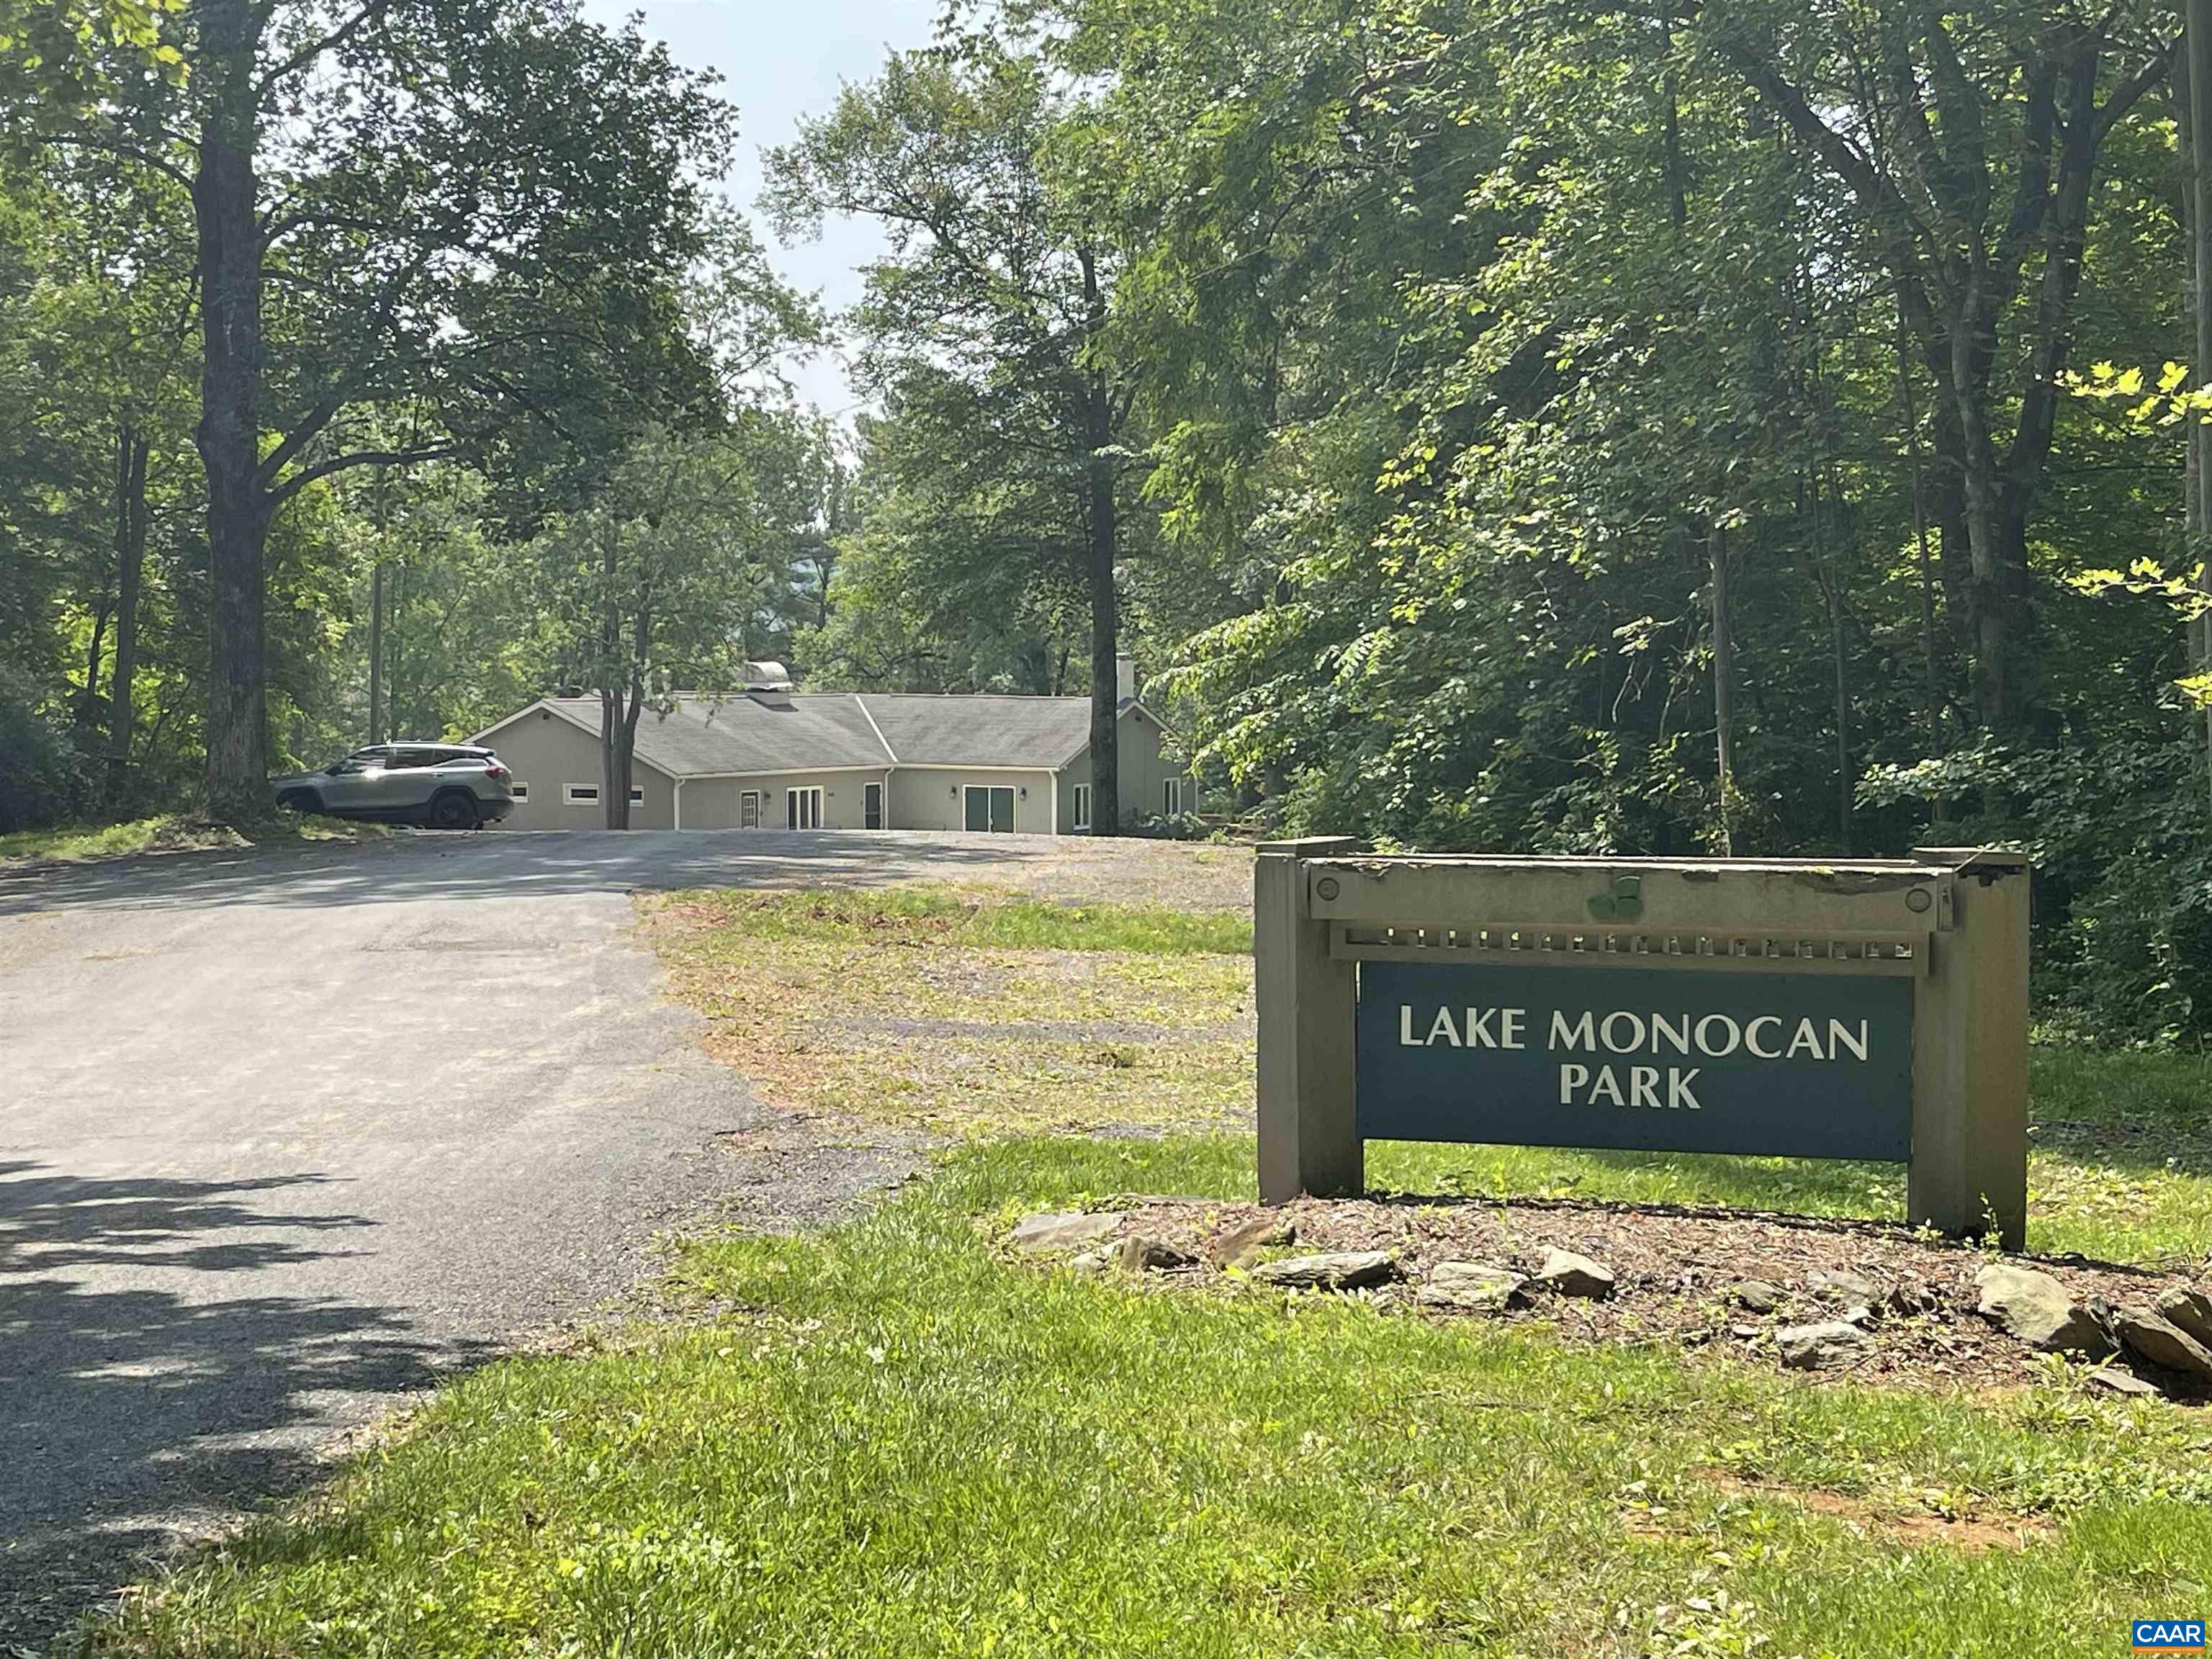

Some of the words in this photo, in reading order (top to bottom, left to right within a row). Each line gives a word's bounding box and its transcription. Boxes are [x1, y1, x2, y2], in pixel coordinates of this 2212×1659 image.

[1401, 1005, 1525, 1049] LAKE
[1547, 1010, 1868, 1061] MONOCAN
[1560, 1064, 1701, 1109] PARK
